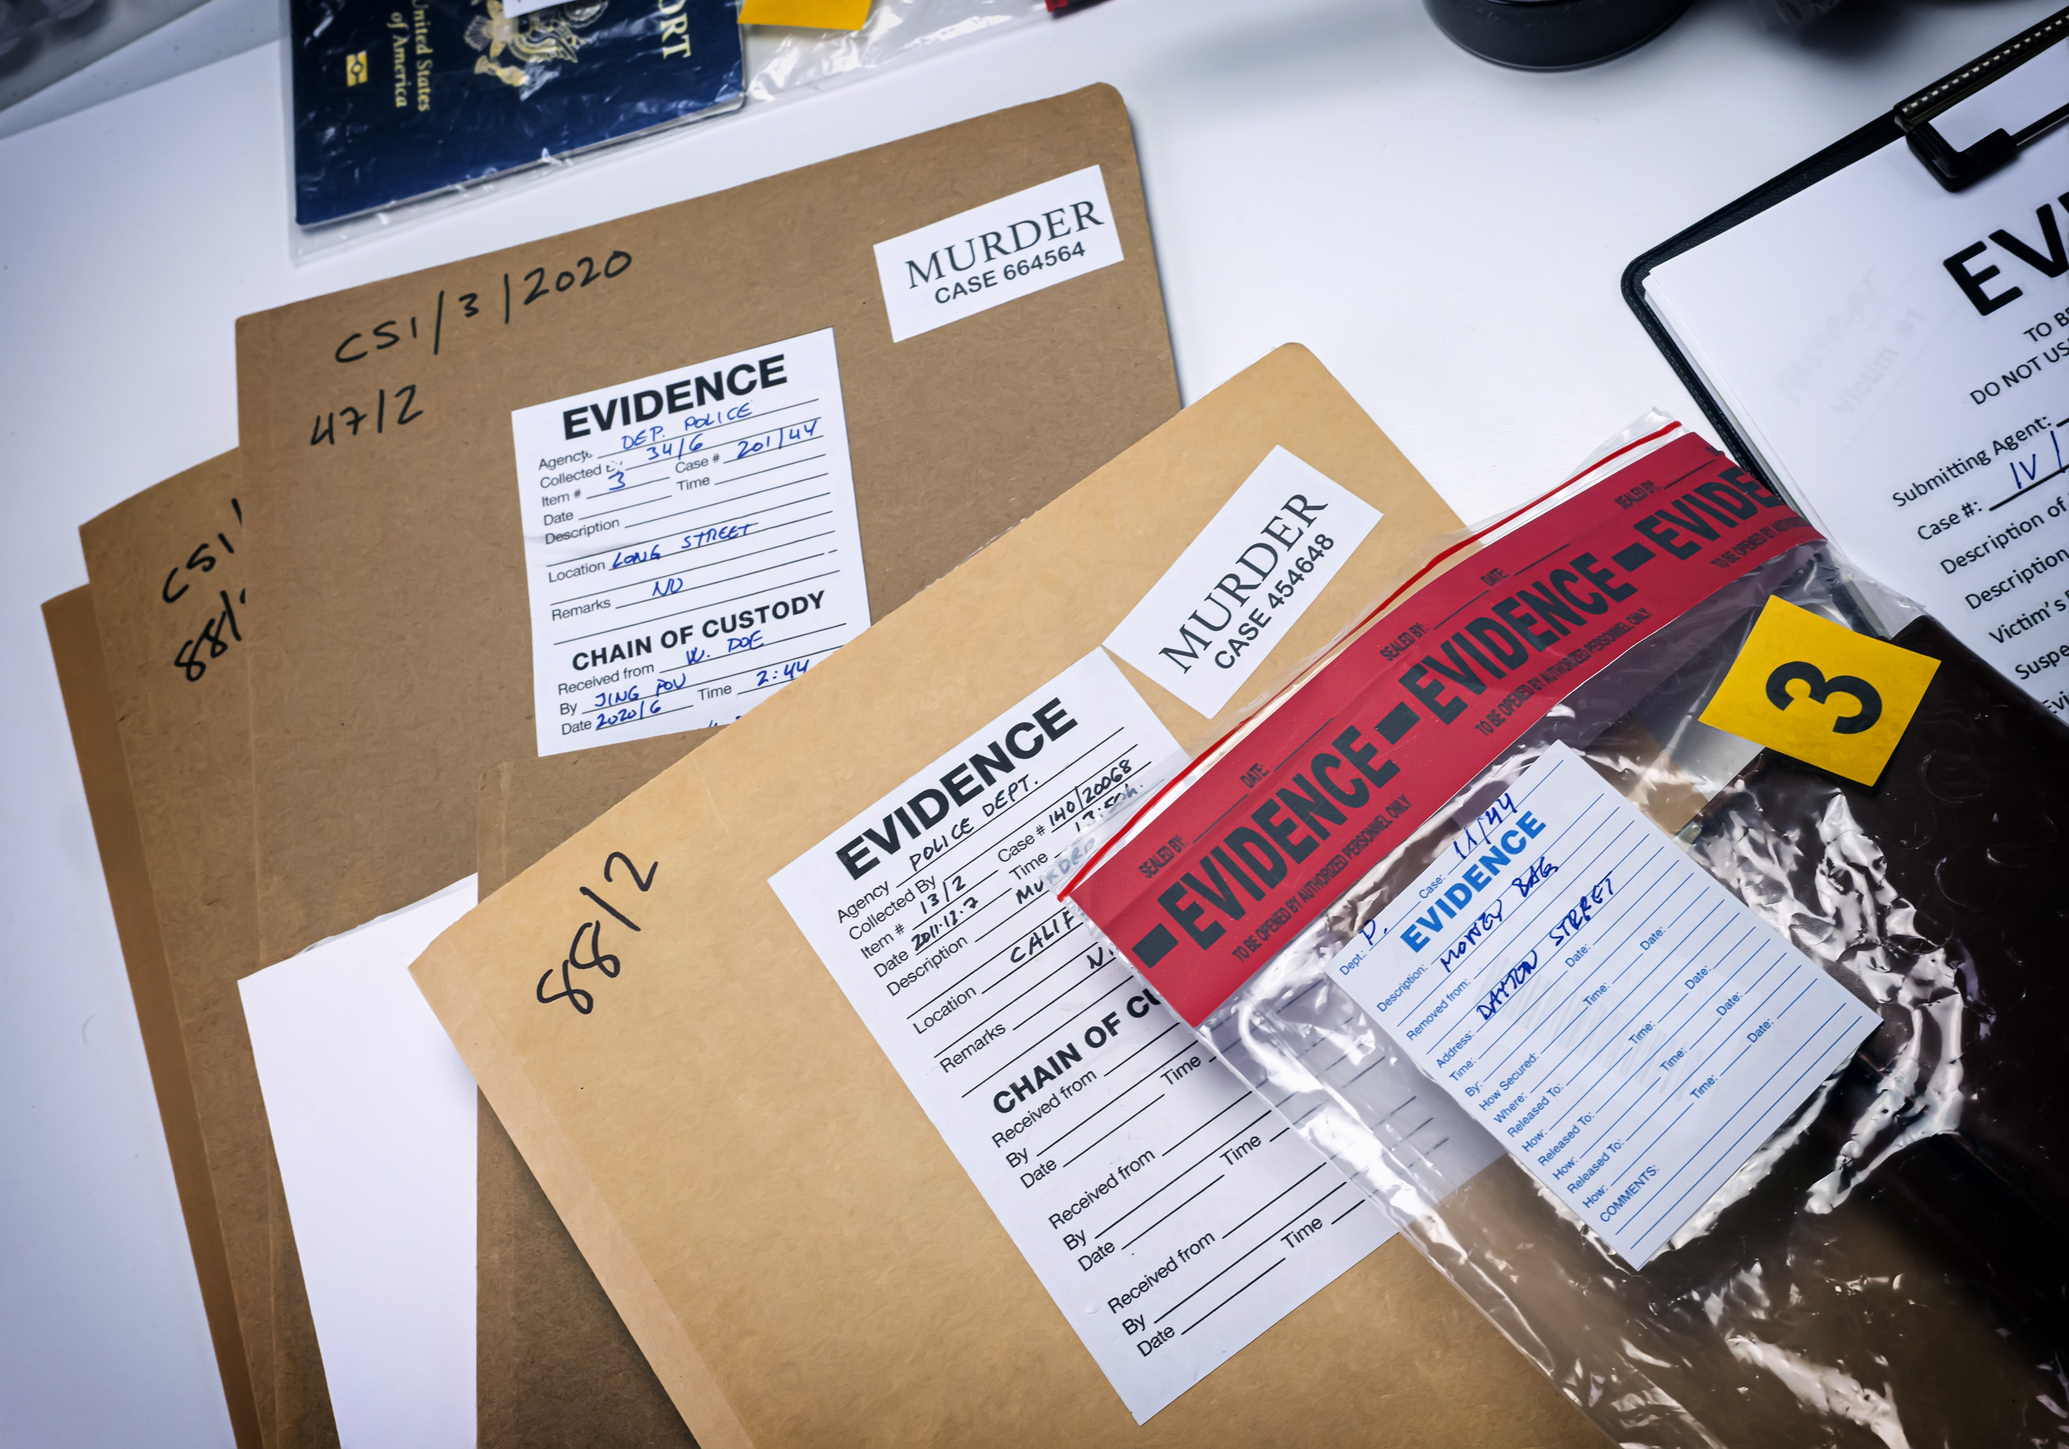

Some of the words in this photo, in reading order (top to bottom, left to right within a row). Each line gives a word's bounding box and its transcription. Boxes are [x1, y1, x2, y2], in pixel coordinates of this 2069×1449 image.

[387, 12, 410, 30] of
[392, 34, 412, 108] America
[416, 59, 433, 112] States
[905, 201, 1104, 289] MURDER
[1943, 190, 2069, 317] EV
[935, 269, 998, 304] CASE
[1003, 241, 1086, 280] 664564
[2023, 322, 2053, 342] TO
[1970, 381, 2001, 405] DO
[2001, 356, 2042, 388] NOT
[2043, 337, 2069, 363] US
[562, 354, 788, 441] EVIDENCE
[684, 401, 753, 431] POLICE
[540, 464, 602, 489] Collected
[675, 458, 709, 475] Case
[1892, 449, 1992, 508] Submitting
[1993, 415, 2052, 455] Agent:
[608, 471, 626, 491] 3
[676, 475, 710, 492] Time
[541, 490, 570, 508] Item
[543, 510, 574, 527] Date
[545, 519, 620, 545] Description
[1916, 510, 1961, 541] Case
[1940, 512, 2045, 576] Description
[2047, 495, 2068, 518] of
[612, 545, 661, 570] LONG
[681, 522, 759, 549] STREET
[548, 560, 606, 583] Location
[1157, 494, 1328, 675] MURDER
[1965, 549, 2069, 610] Description
[551, 598, 612, 621] Remarks
[1214, 607, 1272, 669] CASE
[1267, 533, 1335, 609] 454648
[174, 588, 246, 682] 88/
[571, 635, 653, 671] CHAIN
[660, 625, 694, 650] OF
[702, 590, 825, 638] CUSTODY
[727, 630, 764, 653] DOE
[1380, 631, 1416, 661] SEALED
[1398, 552, 1638, 725] EVIDENCE
[558, 672, 620, 695] Received
[623, 663, 655, 680] from
[697, 684, 733, 702] Time
[559, 701, 578, 718] By
[1765, 661, 1883, 734] 3
[561, 719, 592, 736] Date
[835, 697, 1079, 881] EVIDENCE
[909, 818, 975, 872] POLICE
[982, 774, 1039, 817] DEPT.
[1157, 725, 1400, 951] EVIDENCE
[997, 832, 1036, 863] Case
[1138, 845, 1175, 879] SEALED
[1009, 851, 1048, 880] Time
[1231, 946, 1250, 962] TO
[1243, 935, 1262, 952] BE
[1255, 907, 1292, 941] OPENED
[1285, 896, 1302, 913] BY
[1297, 854, 1349, 904] AUTHORIZED
[1341, 814, 1393, 860] PERSONNEL
[1385, 794, 1412, 819] ONLY
[1400, 811, 1547, 953] EVIDENCE
[837, 881, 890, 923] Agency
[1418, 874, 1446, 899] Case:
[849, 889, 917, 940] Collected
[915, 876, 936, 895] By
[536, 851, 659, 1015] 88/2
[860, 931, 895, 960] Item
[1640, 926, 1667, 952] Date:
[873, 949, 909, 979] Date
[886, 936, 969, 997] Description
[1565, 942, 1592, 968] Date:
[1376, 964, 1428, 1012] Description:
[1684, 964, 1712, 991] Date:
[913, 984, 977, 1035] Location
[1406, 999, 1449, 1041] Removed
[1446, 979, 1471, 1002] from:
[1583, 982, 1610, 1008] Time:
[1716, 990, 1743, 1018] Date:
[940, 1021, 1007, 1073] Remarks
[1628, 1019, 1656, 1046] Time:
[1746, 1017, 1775, 1044] Date:
[992, 1043, 1084, 1114] CHAIN
[1084, 1012, 1122, 1049] OF
[1435, 1030, 1476, 1069] Address:
[1660, 1046, 1688, 1073] Time:
[1160, 1053, 1202, 1088] Time
[1449, 1057, 1477, 1082] Time:
[1478, 1090, 1502, 1111] How
[1499, 1052, 1540, 1091] Secured:
[1464, 1081, 1483, 1098] By:
[1690, 1074, 1718, 1101] Time:
[991, 1091, 1062, 1149] Received
[1058, 1068, 1097, 1100] from
[1493, 1092, 1528, 1124] Where:
[1507, 1096, 1550, 1138] Released
[1546, 1083, 1564, 1099] To:
[1219, 1133, 1263, 1168] Time
[1521, 1128, 1548, 1152] How:
[1537, 1124, 1580, 1166] Released
[1577, 1112, 1595, 1127] To:
[1005, 1147, 1031, 1170] By
[1019, 1157, 1058, 1189] Date
[1552, 1156, 1579, 1181] How:
[1566, 1152, 1610, 1194] Released
[1606, 1139, 1625, 1154] To:
[1048, 1171, 1120, 1230] Received
[1117, 1149, 1157, 1182] from
[1582, 1184, 1609, 1209] How:
[1600, 1164, 1660, 1222] COMMENTS:
[1062, 1229, 1087, 1251] By
[1280, 1214, 1324, 1250] Time
[1077, 1239, 1116, 1272] Date
[1107, 1257, 1179, 1315] Received
[1176, 1230, 1216, 1265] from
[1121, 1313, 1147, 1336] By
[1136, 1323, 1176, 1357] Date
